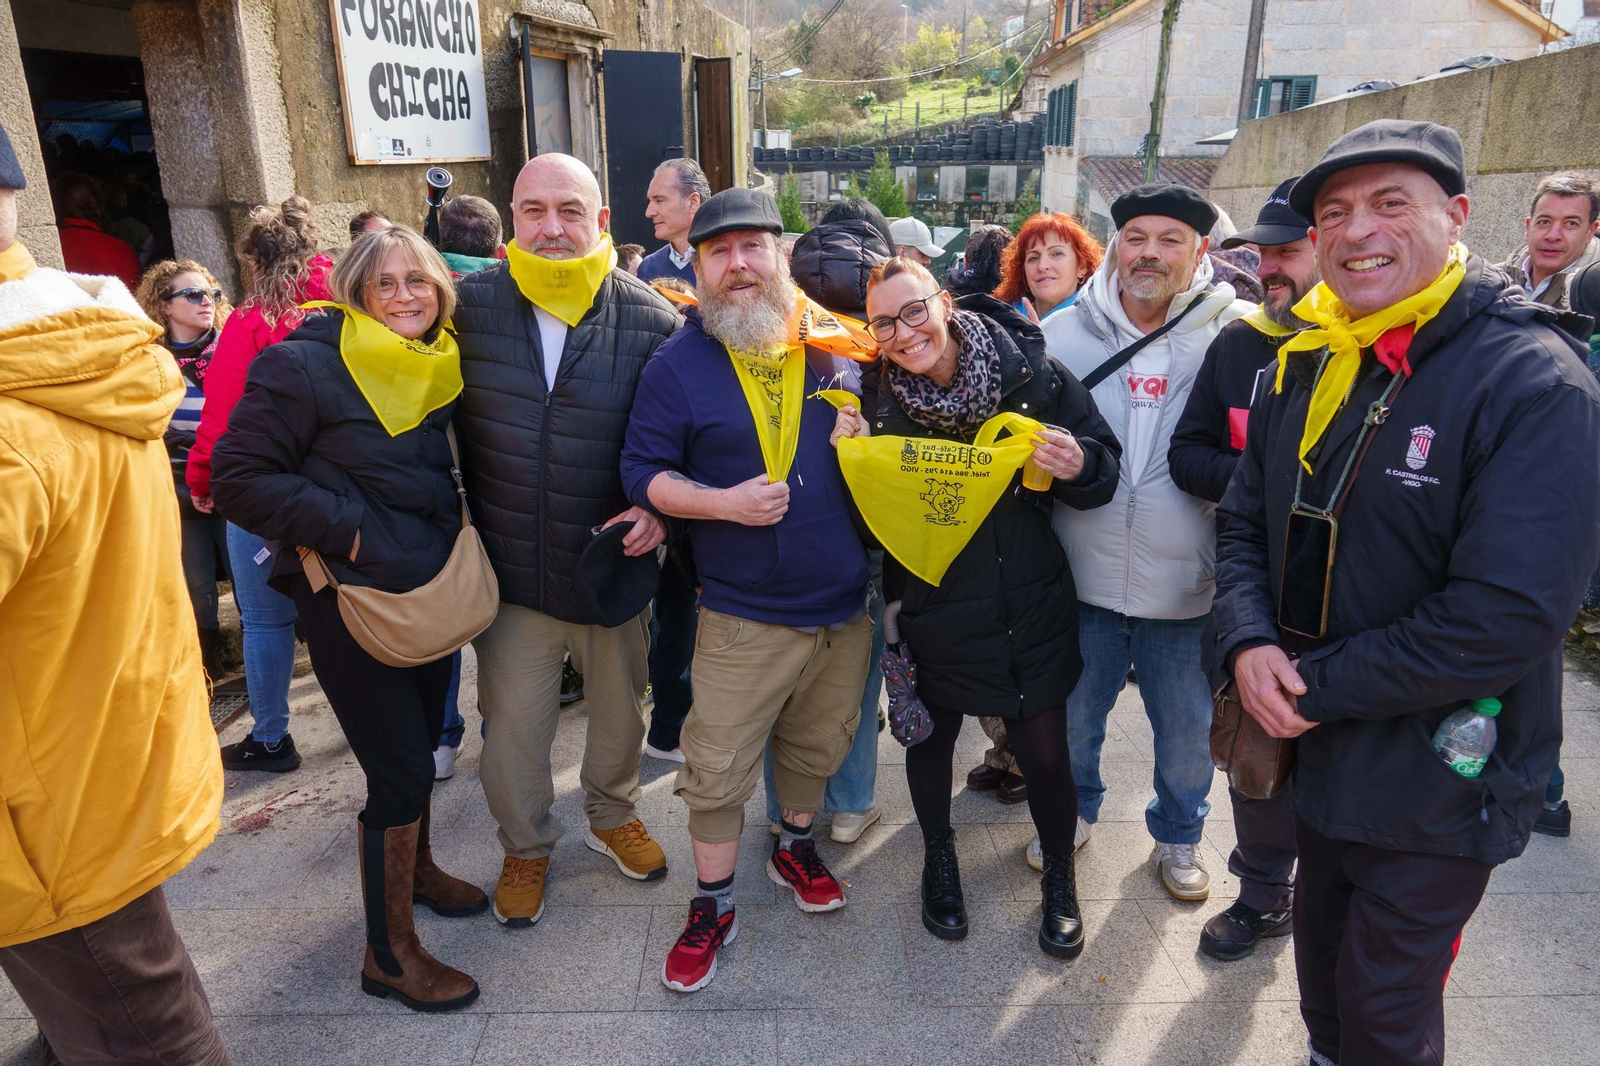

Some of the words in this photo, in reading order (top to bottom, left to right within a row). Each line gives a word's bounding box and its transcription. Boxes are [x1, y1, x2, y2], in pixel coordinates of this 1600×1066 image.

[369, 62, 471, 121] CHICHA
[195, 358, 207, 369] DO
[1392, 469, 1429, 482] CASTRELOS
